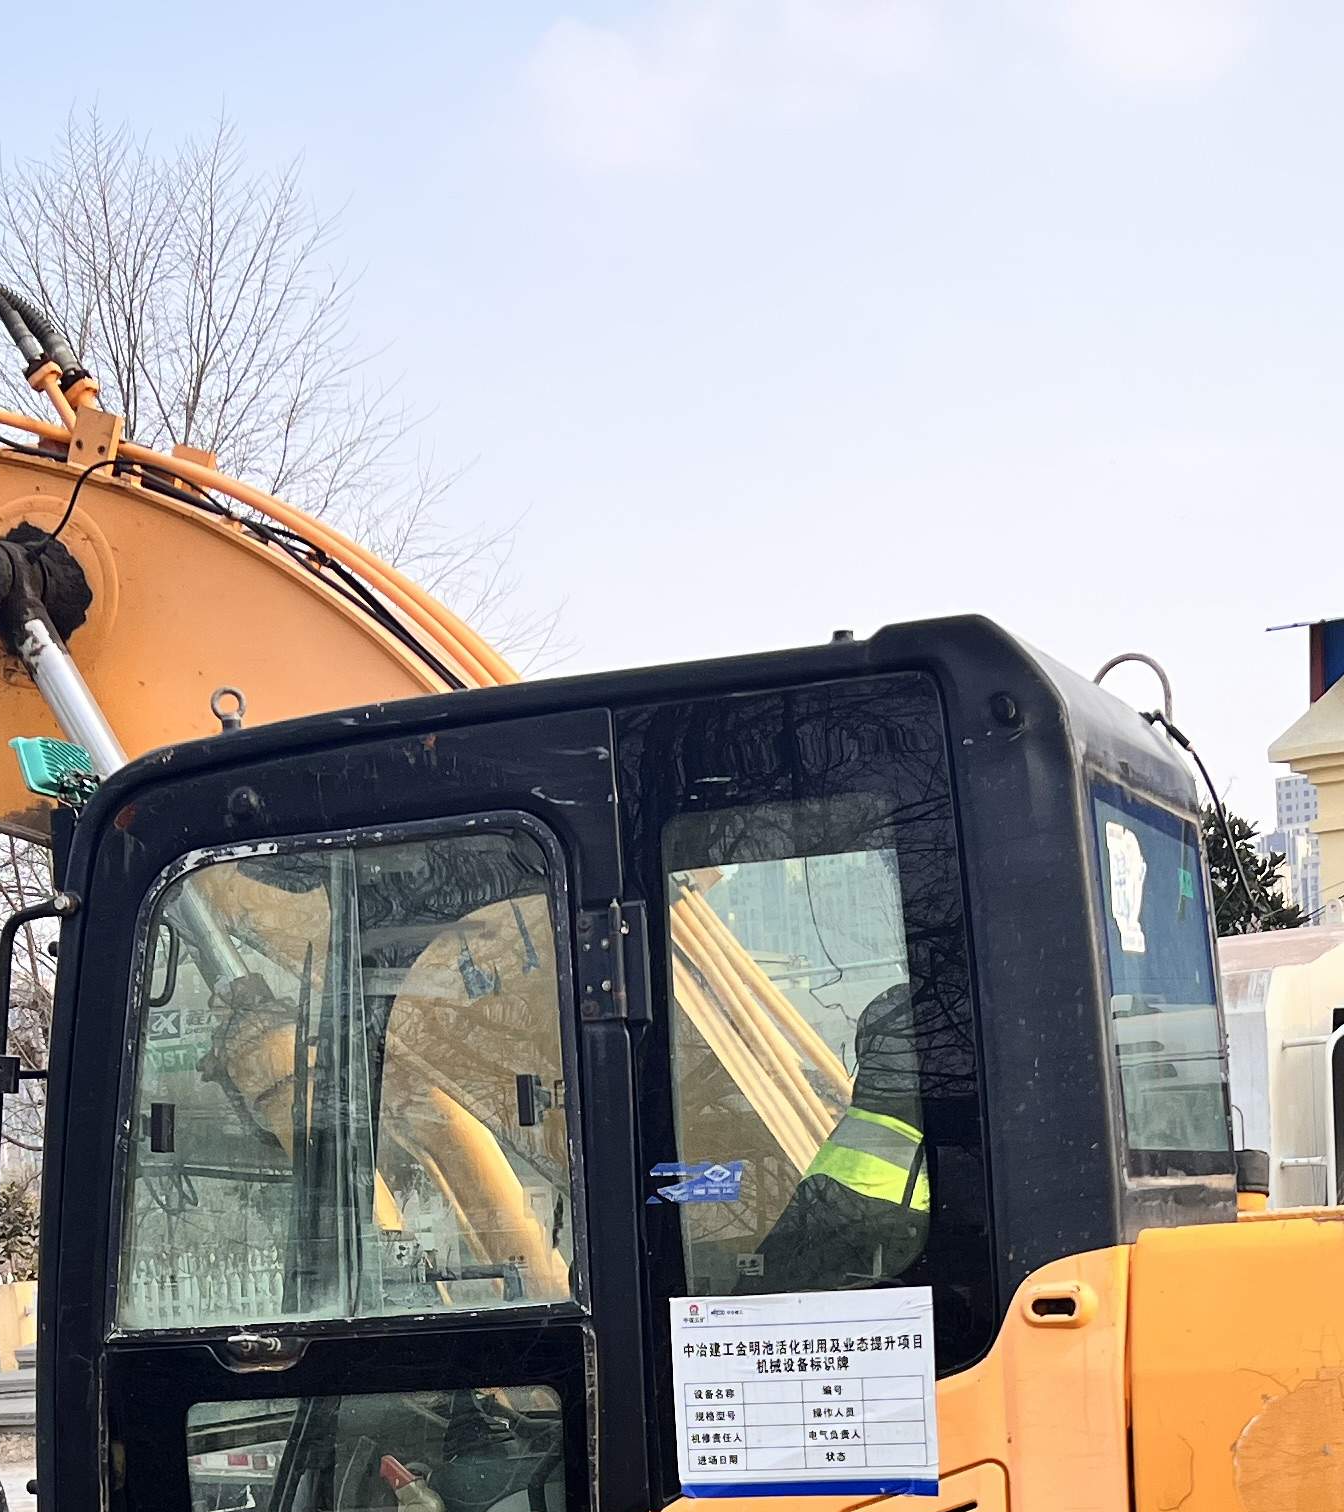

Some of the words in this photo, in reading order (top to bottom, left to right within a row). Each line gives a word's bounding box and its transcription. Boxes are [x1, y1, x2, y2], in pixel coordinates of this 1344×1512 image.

[756, 1356, 850, 1374] 机械设备标识牌
[694, 1389, 735, 1400] 设备名称
[822, 1385, 842, 1395] 编号
[825, 1452, 846, 1462] 状态
